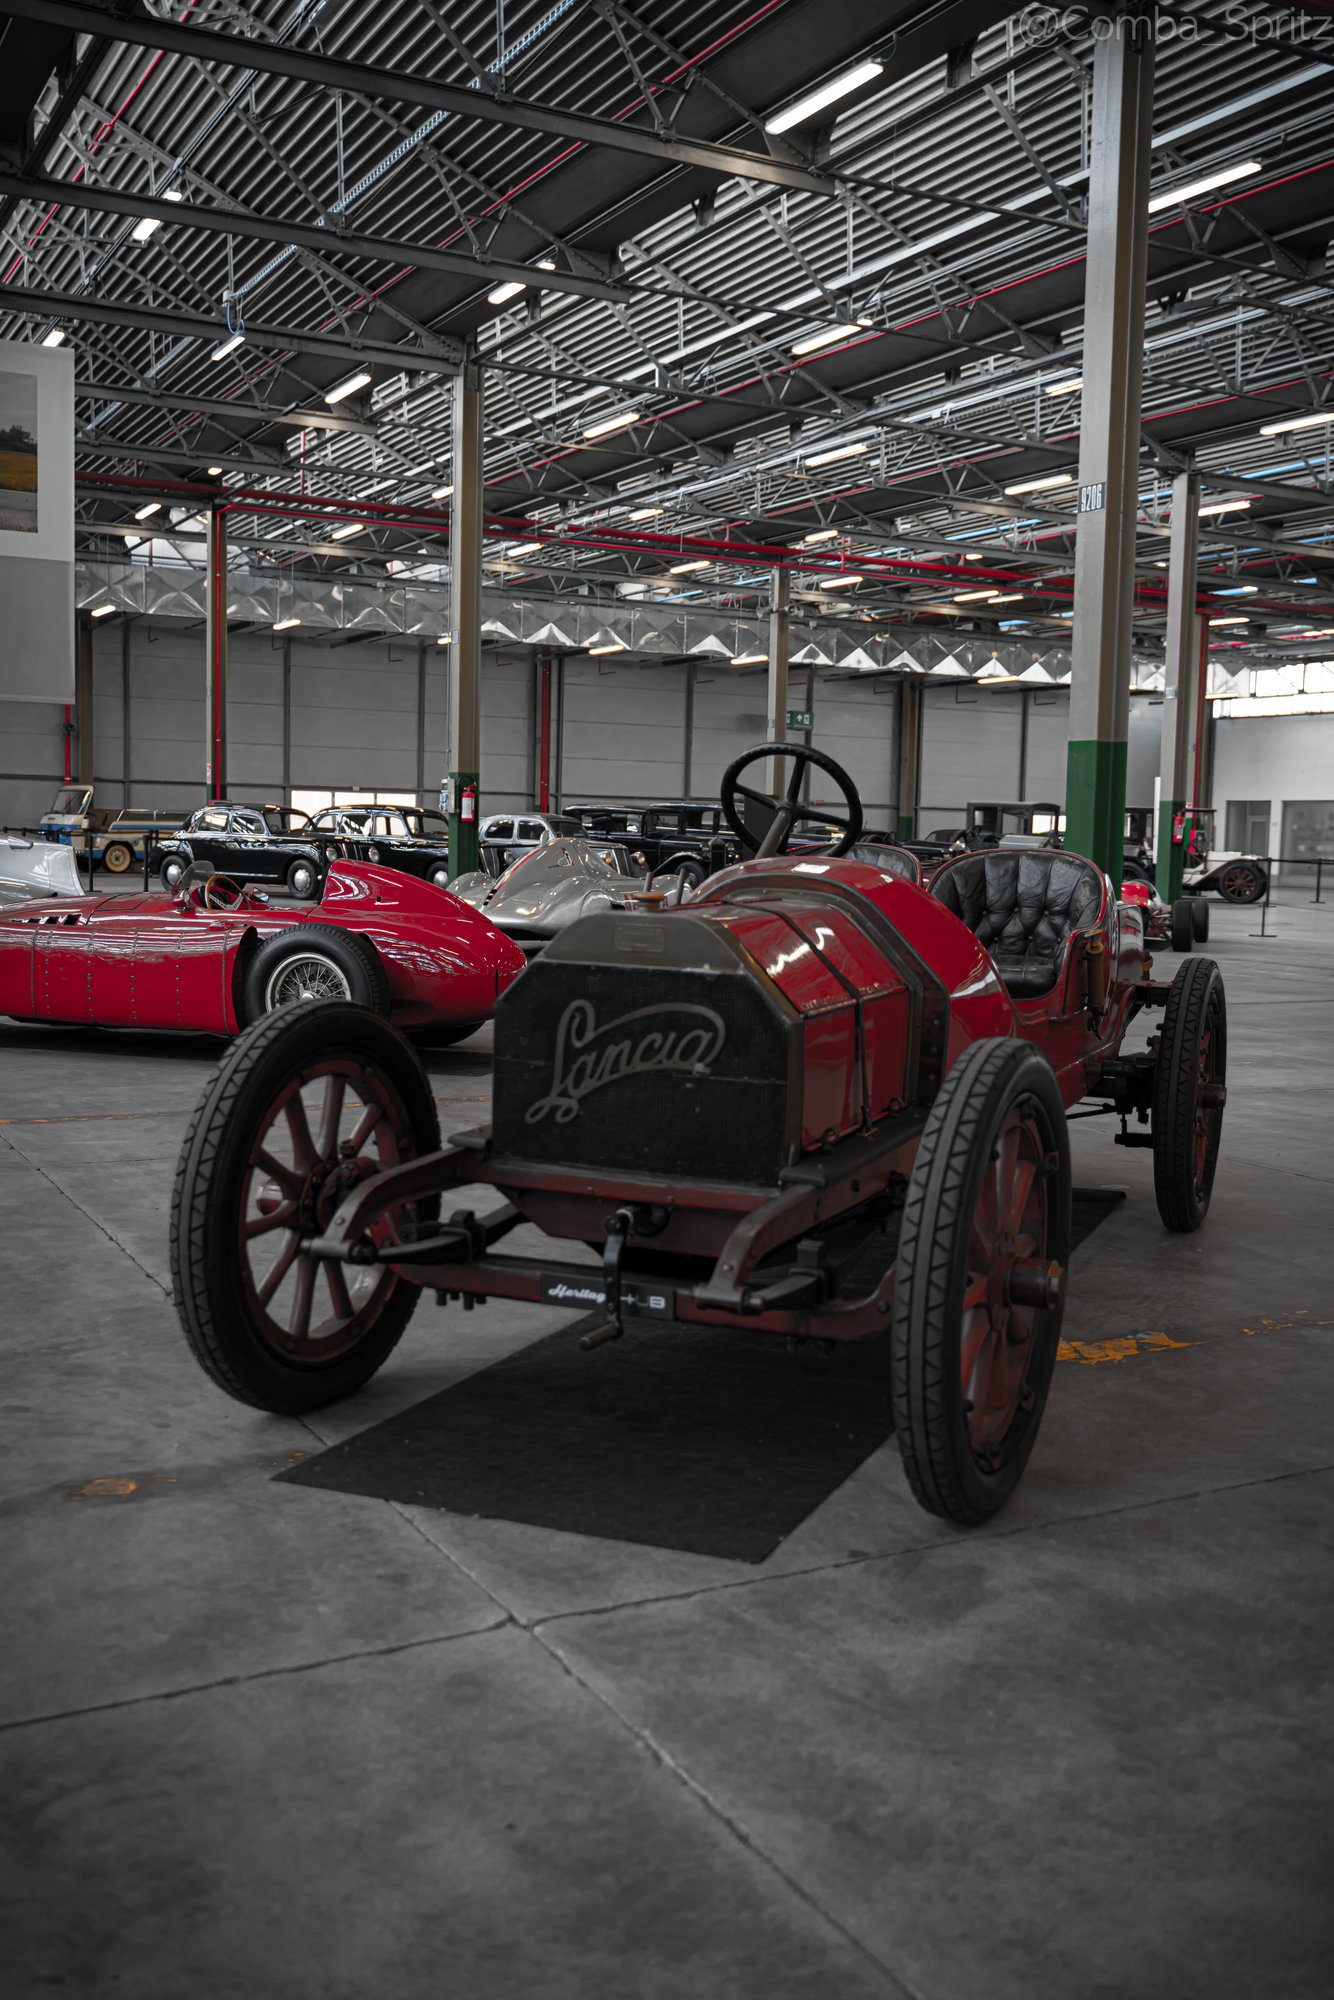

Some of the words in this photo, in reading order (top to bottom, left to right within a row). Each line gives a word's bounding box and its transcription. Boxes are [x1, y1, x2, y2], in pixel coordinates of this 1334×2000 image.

[1081, 483, 1102, 512] 9206
[525, 999, 726, 1124] Lancia
[548, 1283, 607, 1304] Heritag
